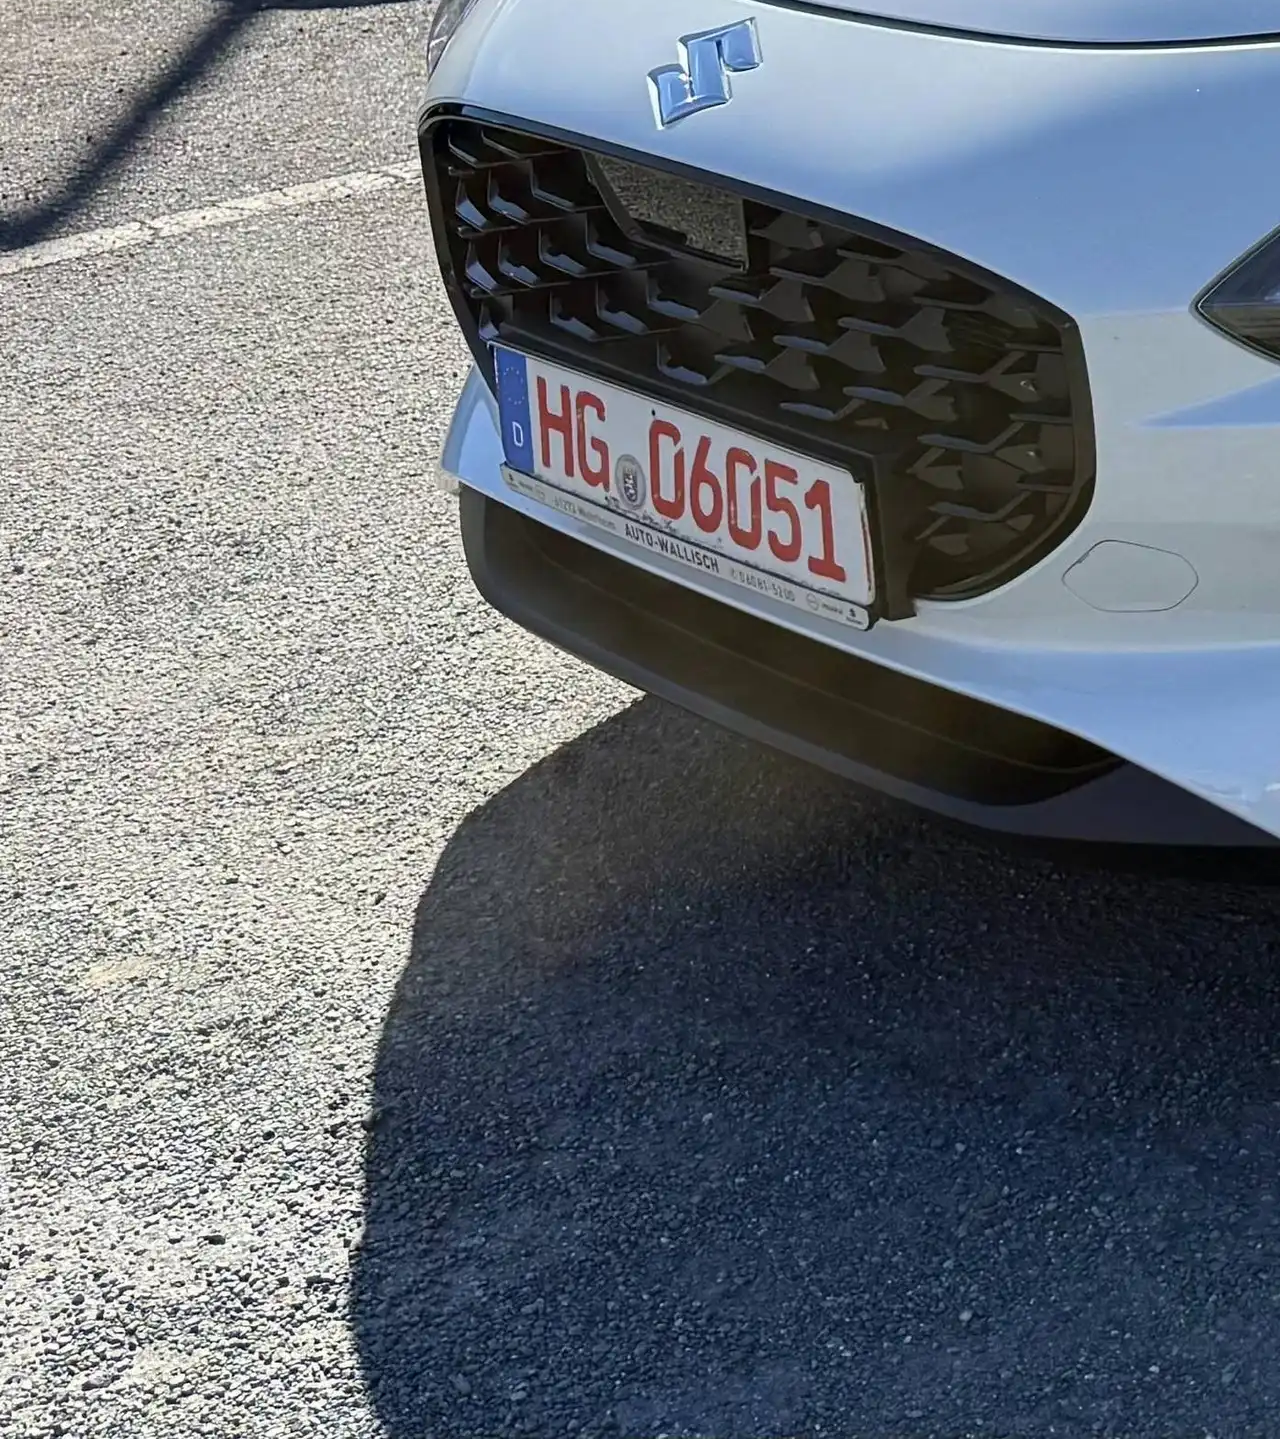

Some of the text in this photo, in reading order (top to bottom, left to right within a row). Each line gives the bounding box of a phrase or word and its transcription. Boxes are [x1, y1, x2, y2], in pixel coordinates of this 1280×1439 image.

[513, 421, 524, 448] D
[536, 376, 847, 583] HG 06051
[625, 523, 720, 573] AUTO-WALLISCH
